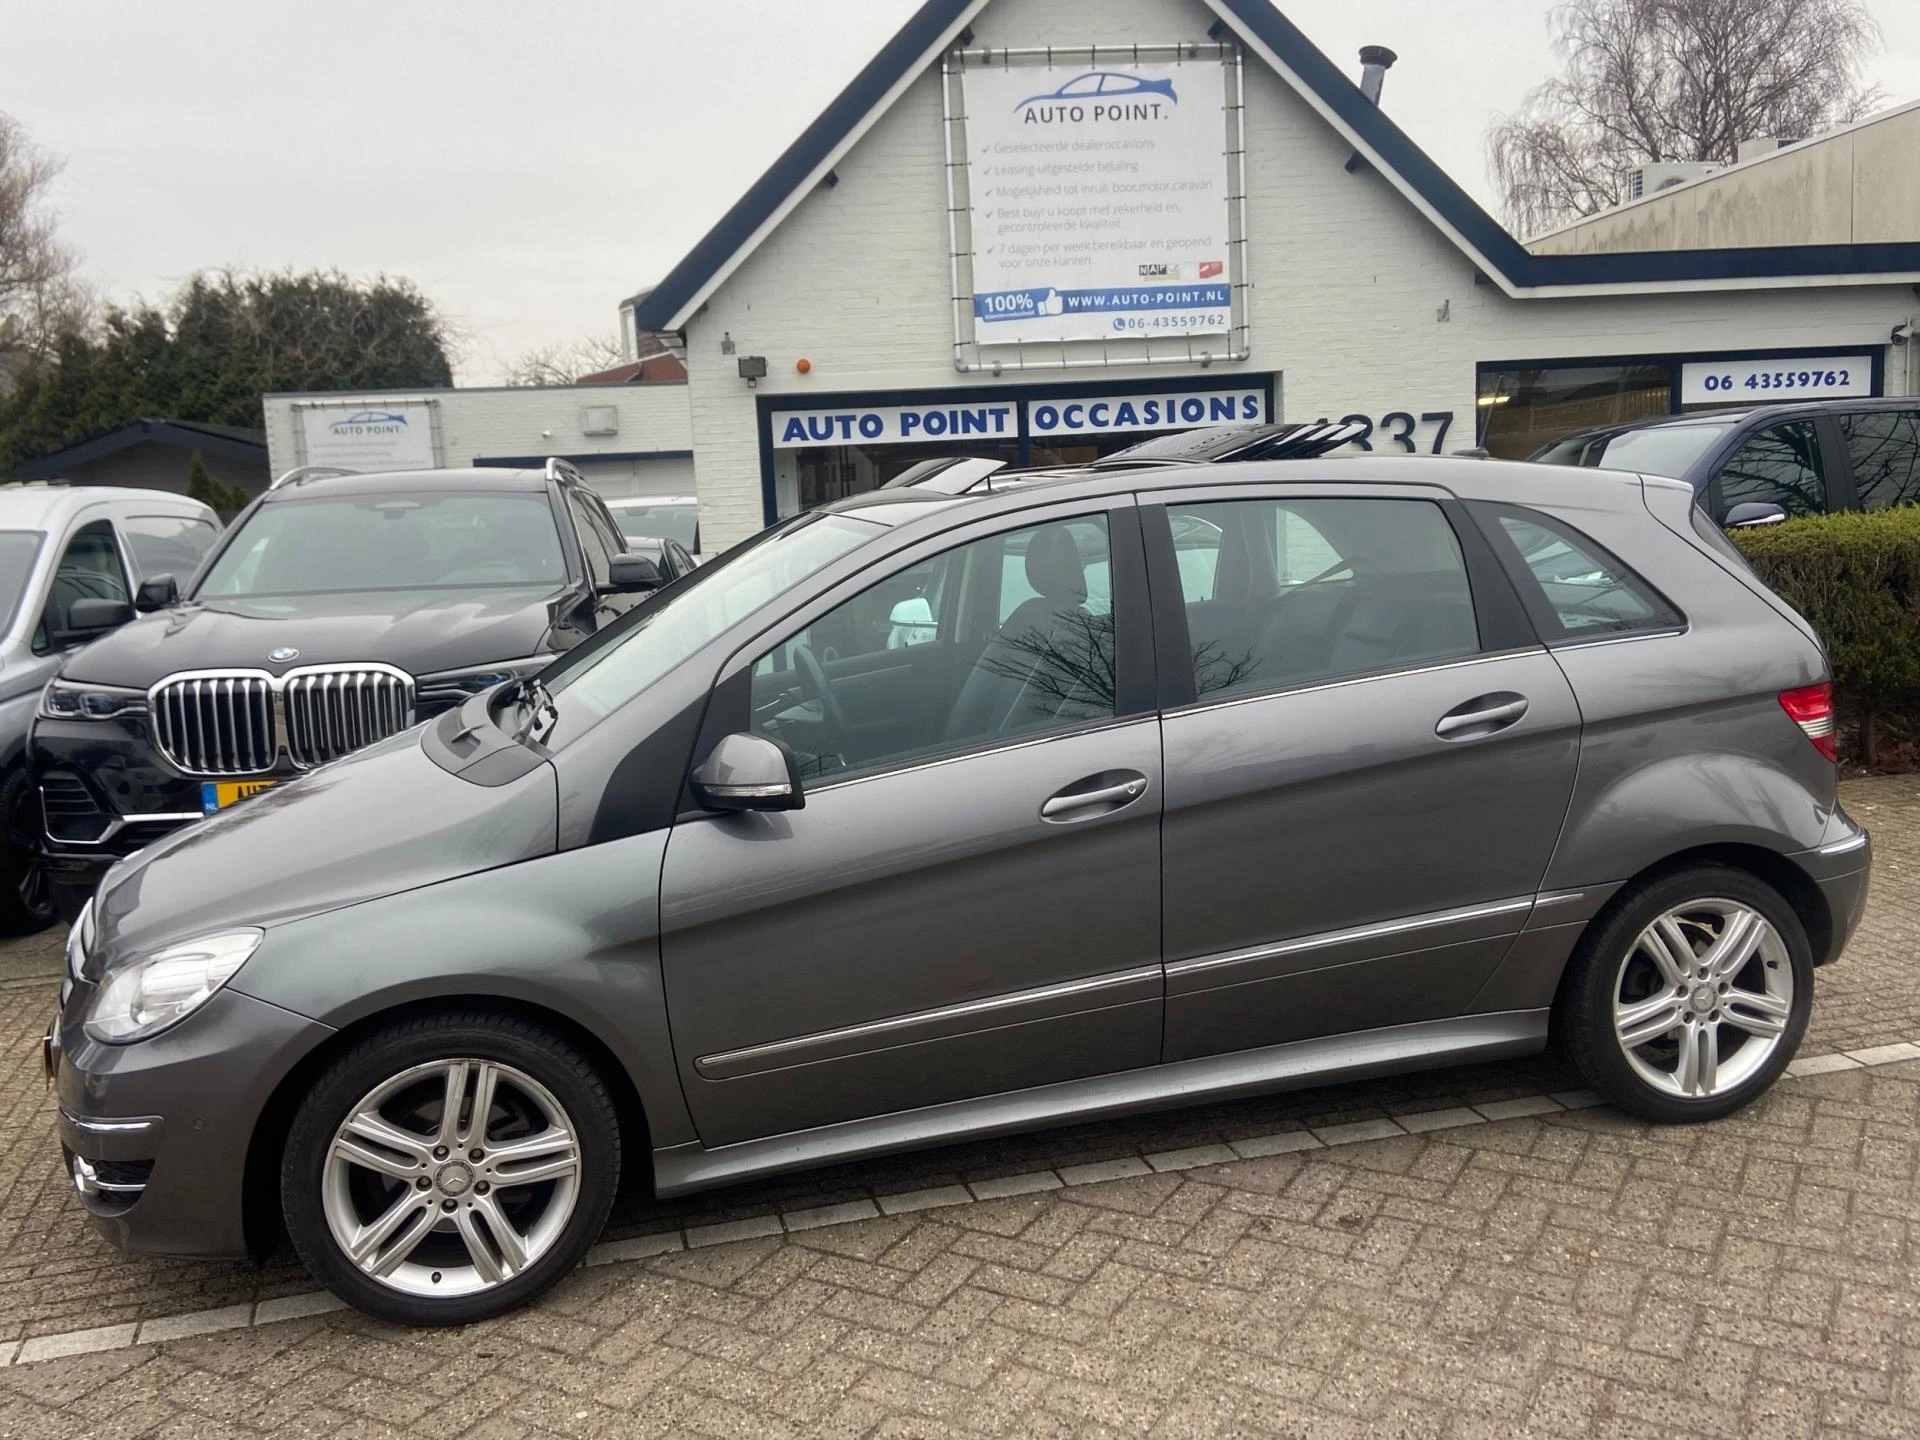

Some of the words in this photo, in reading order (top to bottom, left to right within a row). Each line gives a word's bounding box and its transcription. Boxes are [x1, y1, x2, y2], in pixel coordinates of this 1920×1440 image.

[1023, 105, 1085, 124] AUTO
[1070, 138, 1157, 152] dealeroccasions
[1097, 159, 1140, 174] betaling
[1064, 184, 1080, 195] tot
[997, 207, 1020, 219] Best
[1047, 209, 1055, 217] u
[1057, 204, 1087, 218] koopt
[1089, 205, 1110, 216] met
[1112, 201, 1163, 215] zekerheid
[997, 219, 1078, 235] gecontroleerde
[1079, 217, 1122, 231] kwaliteit
[999, 243, 1006, 254] 7
[1008, 243, 1041, 256] dagen
[1042, 244, 1060, 255] per
[1062, 240, 1090, 252] week
[1092, 238, 1148, 251] bereikbaar
[1150, 239, 1164, 250] en
[1166, 234, 1212, 252] geopend
[999, 259, 1022, 269] voor
[1024, 257, 1051, 268] onze
[1052, 254, 1092, 267] klanten
[1140, 263, 1167, 276] NAP
[985, 293, 1034, 312] 100%
[1068, 291, 1225, 308] WWW.AUTO-POINT.NL
[1128, 314, 1225, 329] 06-43559762
[1704, 374, 1733, 391] 06
[1744, 369, 1850, 389] 43559762
[1034, 394, 1257, 430] OCCASIONS
[333, 425, 363, 435] AUTO
[782, 413, 884, 442] AUTO
[900, 408, 1009, 437] POINT
